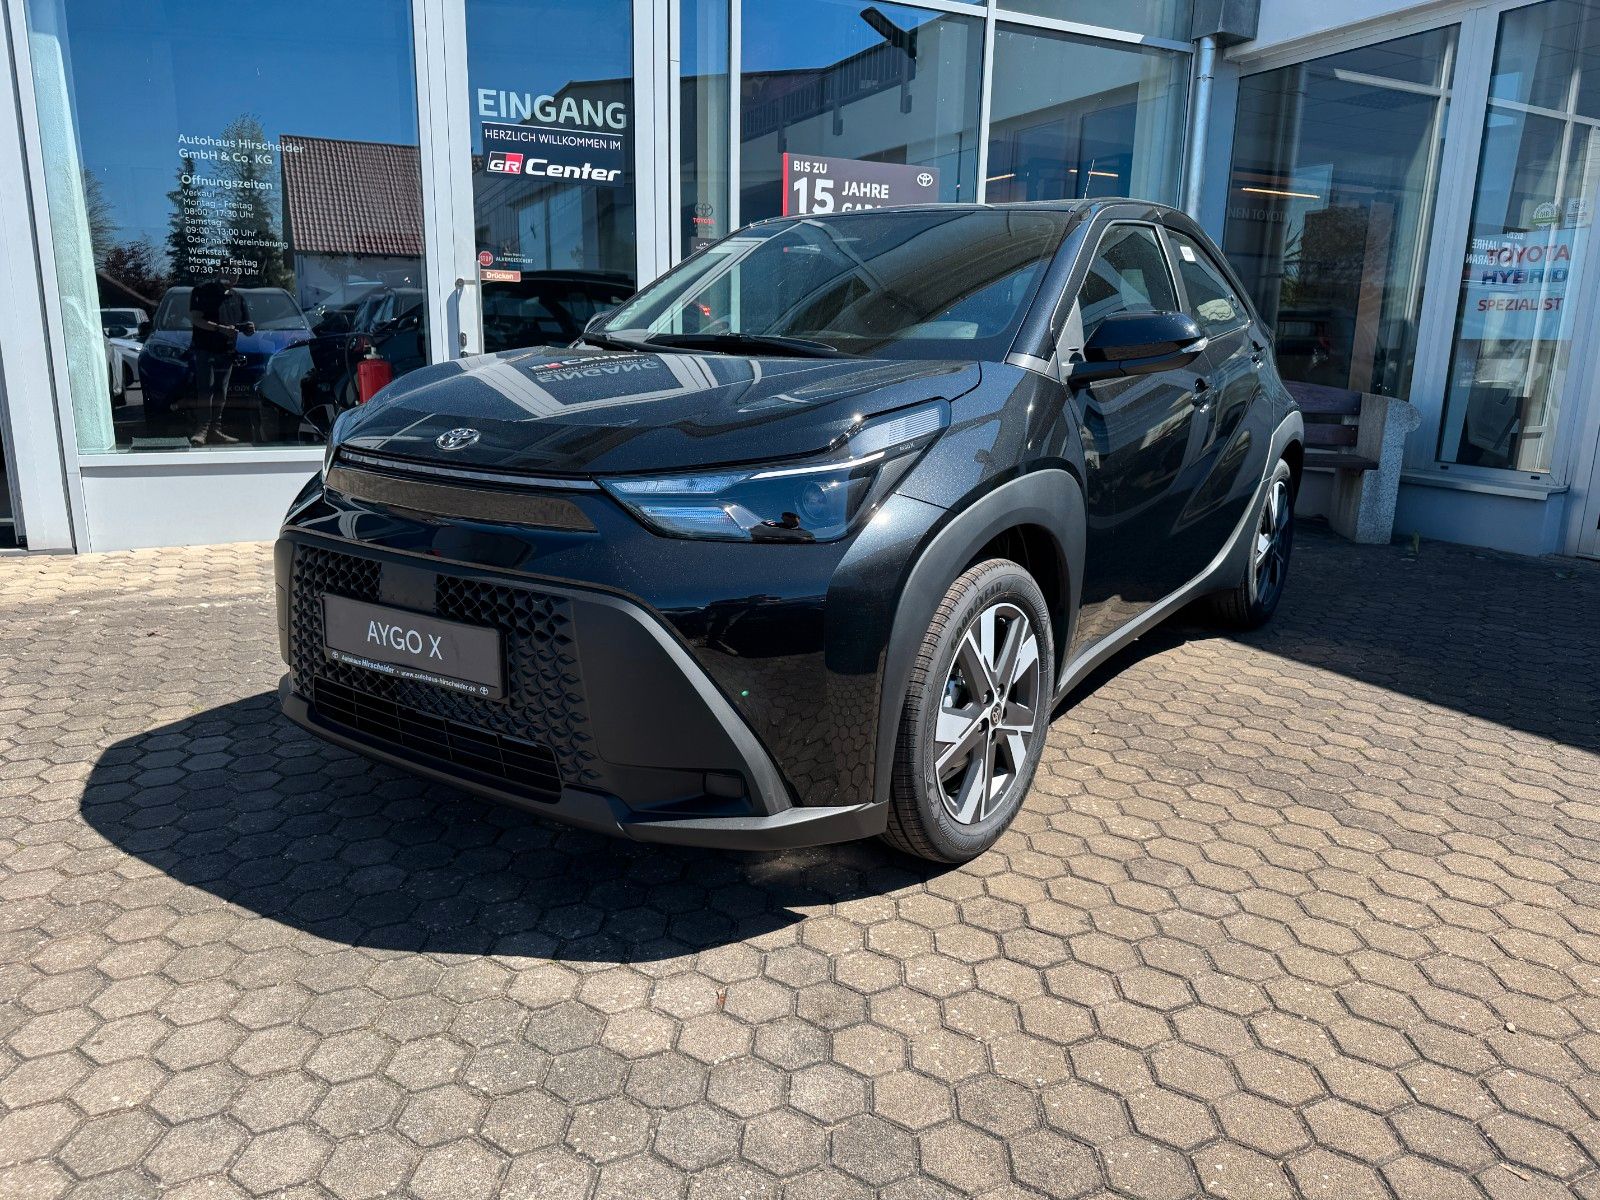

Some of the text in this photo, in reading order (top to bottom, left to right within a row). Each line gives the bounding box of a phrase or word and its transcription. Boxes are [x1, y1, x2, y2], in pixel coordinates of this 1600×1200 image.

[478, 88, 626, 129] EINGANG
[178, 134, 304, 154] Autohaus Hirscheider
[485, 129, 621, 150] HERZLICH WILLKOMMEN IM
[178, 148, 273, 165] GmbH & Co. KG
[490, 158, 622, 182] GR Center
[793, 161, 827, 173] BIS ZU
[181, 172, 273, 190] Öffnungszeiten
[182, 189, 215, 198] Verkauf
[793, 177, 834, 214] 15
[842, 181, 889, 199] JAHRE
[183, 198, 215, 208] Montag
[224, 201, 252, 211] Freitag
[185, 216, 222, 226] Samstag
[187, 236, 208, 244] Oder
[233, 238, 288, 249] Vereinbarung
[188, 247, 230, 256] Werkstatt
[189, 257, 221, 266] Montag
[230, 258, 258, 268] Freitag
[486, 272, 514, 280] Drücken
[1478, 298, 1563, 311] SPEZIALST
[367, 621, 442, 660] AYGO X
